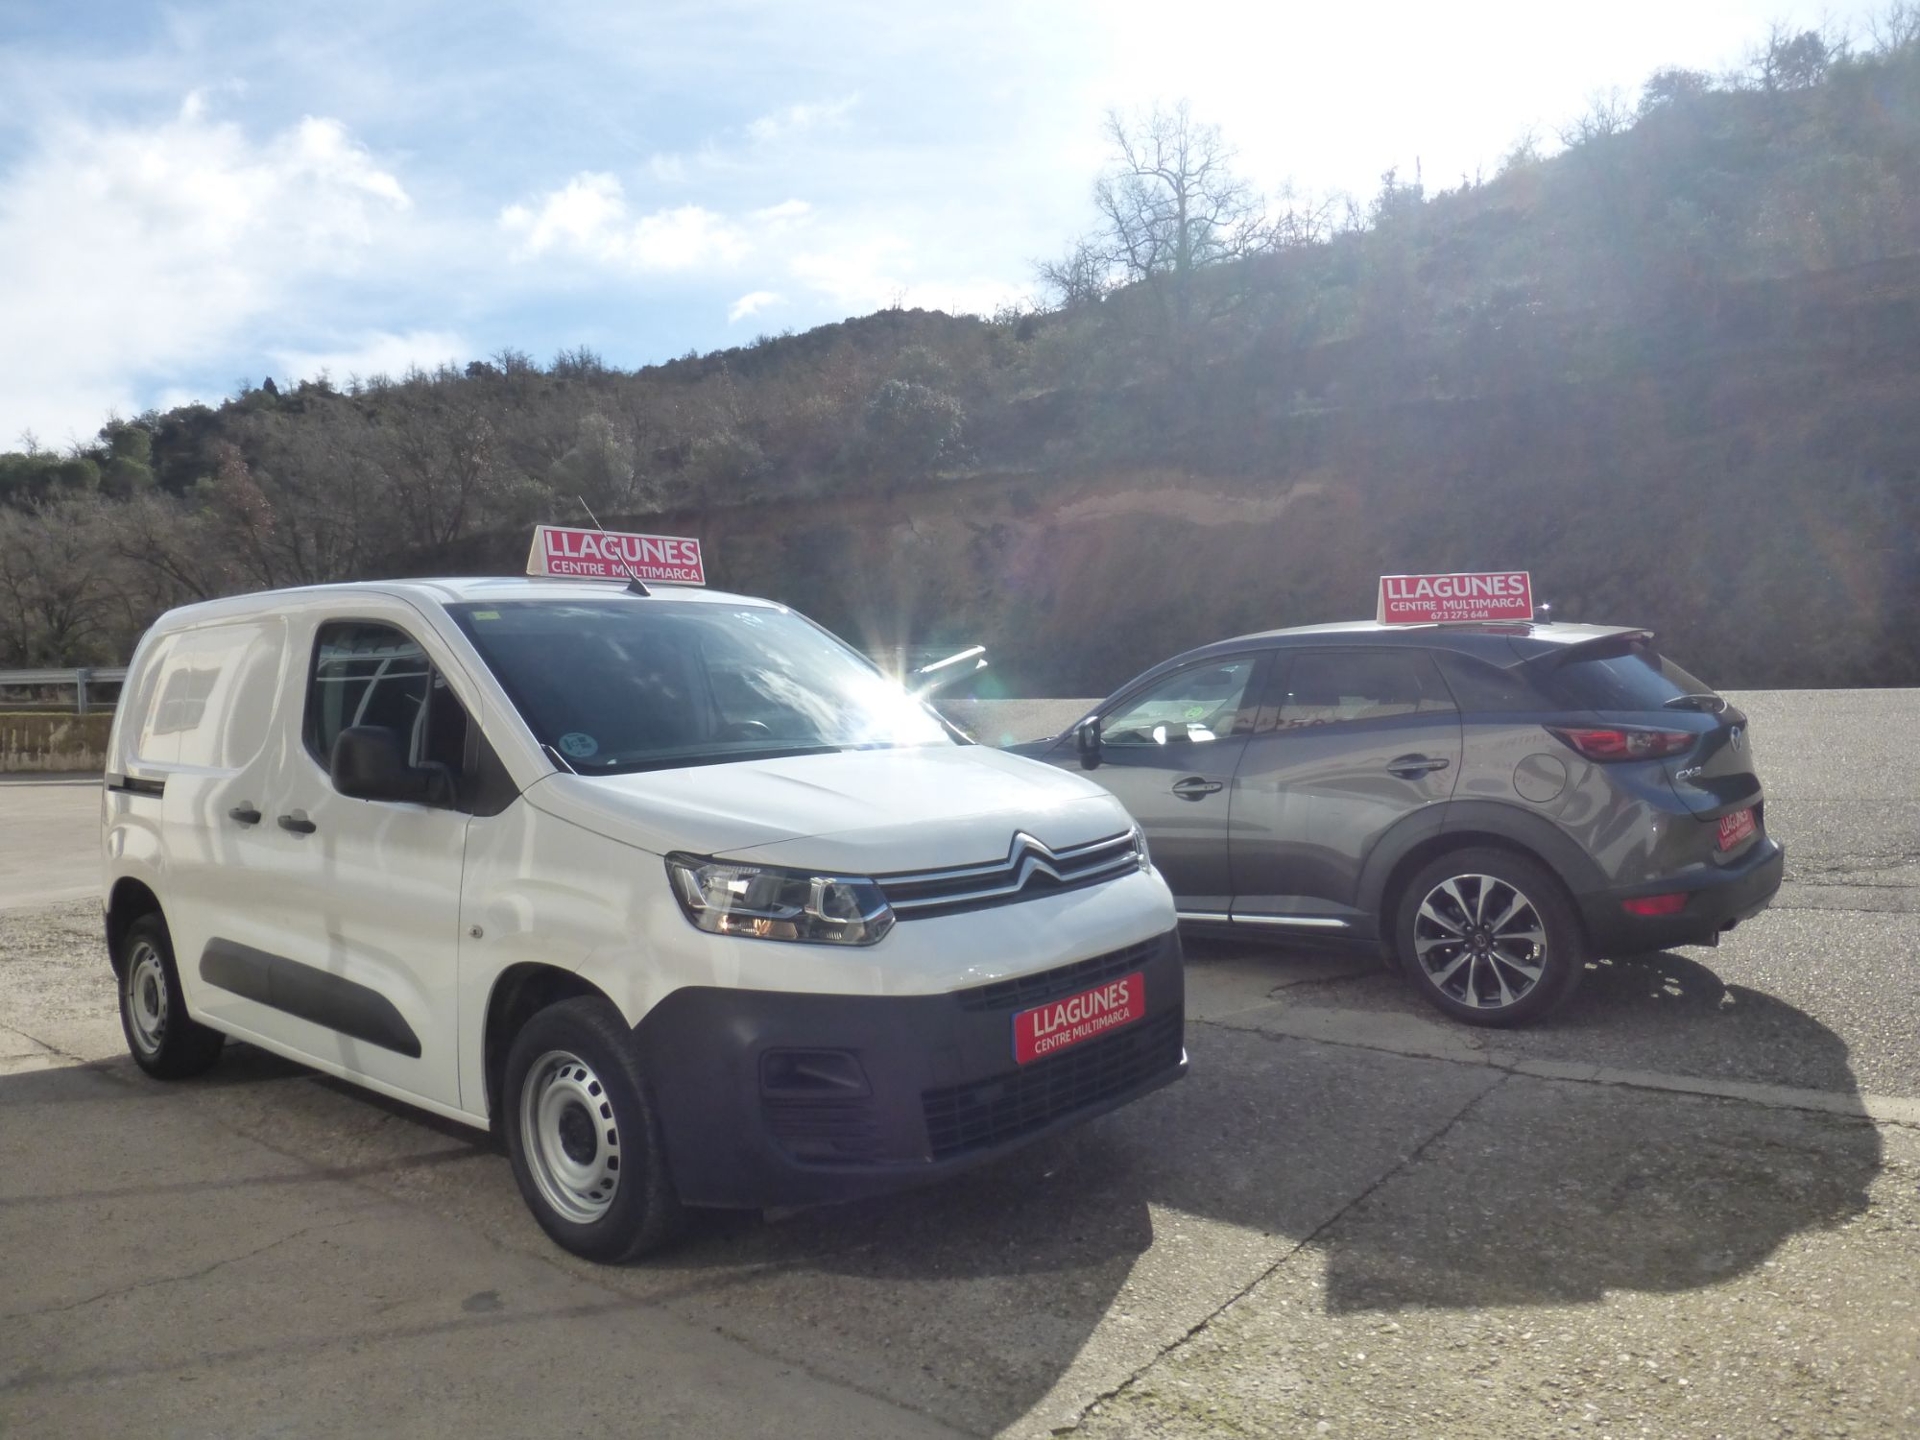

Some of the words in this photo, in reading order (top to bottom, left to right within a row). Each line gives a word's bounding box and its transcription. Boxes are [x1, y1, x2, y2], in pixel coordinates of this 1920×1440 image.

[546, 531, 698, 565] LLAGUNES
[551, 560, 605, 575] CENTRE
[612, 564, 699, 580] MULTIMARCA
[1387, 575, 1525, 599] LLAGUNES
[1390, 602, 1437, 612] CENTRE
[1443, 598, 1525, 610] MULTIMARCA
[1431, 612, 1449, 620] 673
[1451, 611, 1469, 619] 275
[1470, 610, 1489, 618] 644
[1033, 980, 1129, 1037] LLAGUNES
[1034, 1029, 1072, 1054] CENTRE
[1072, 1007, 1130, 1040] MULTIMARCA
